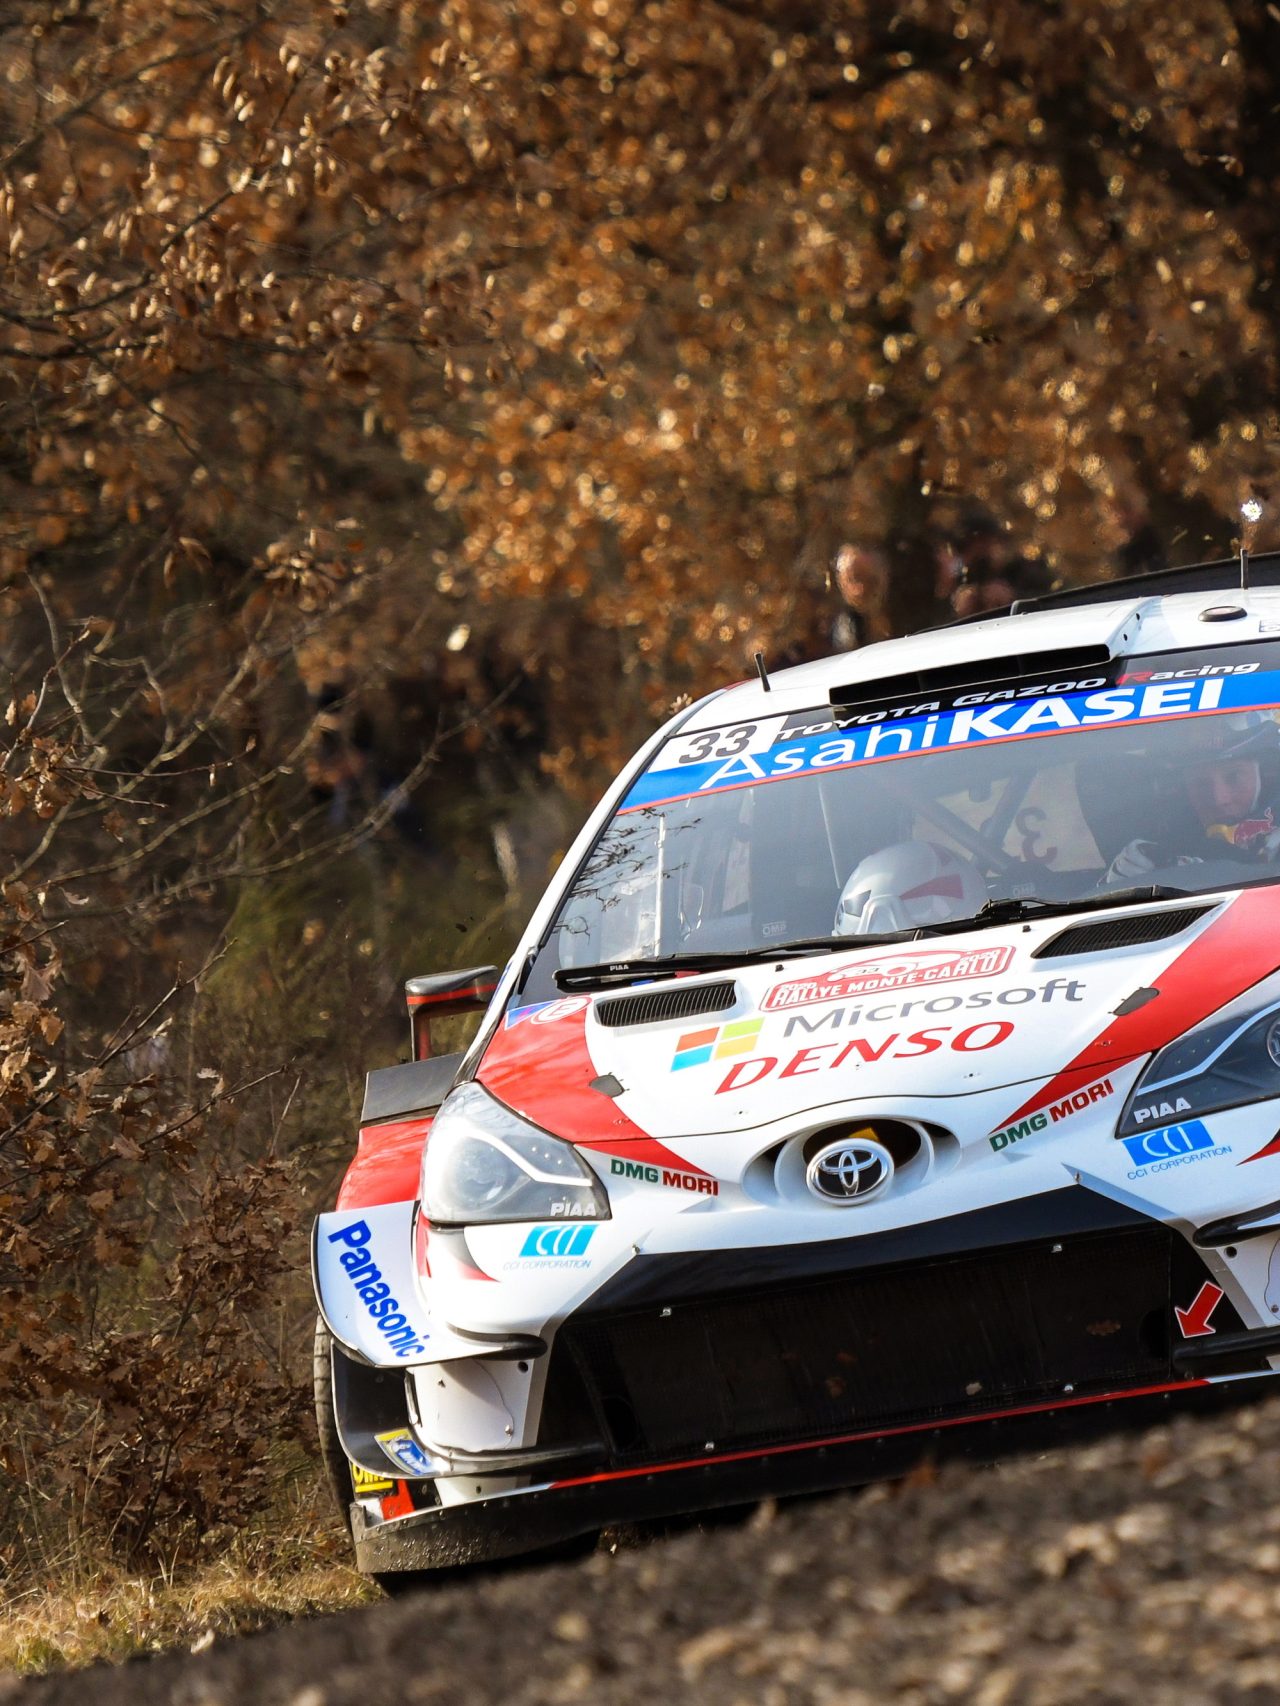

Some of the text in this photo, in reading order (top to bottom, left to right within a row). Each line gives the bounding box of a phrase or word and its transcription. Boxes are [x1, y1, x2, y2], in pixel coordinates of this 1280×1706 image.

[776, 662, 1261, 740] TOYOTA GAZOO Racing
[679, 725, 757, 765] 33
[700, 678, 1225, 790] AsahiKASEI
[762, 922, 787, 936] OMP
[772, 954, 999, 1008] RALLYE MONTE-CARLO
[784, 978, 1087, 1038] Microsoft
[715, 1021, 1015, 1095] DENSO
[988, 1079, 1115, 1152] DMG MORI
[1134, 1097, 1192, 1124] PIAA
[610, 1159, 720, 1197] DMG MORI
[1127, 1145, 1233, 1180] CCI CORPORATION
[550, 1202, 598, 1217] PIAA
[327, 1219, 431, 1358] Panasonic
[503, 1259, 592, 1271] CCI CORPORATION
